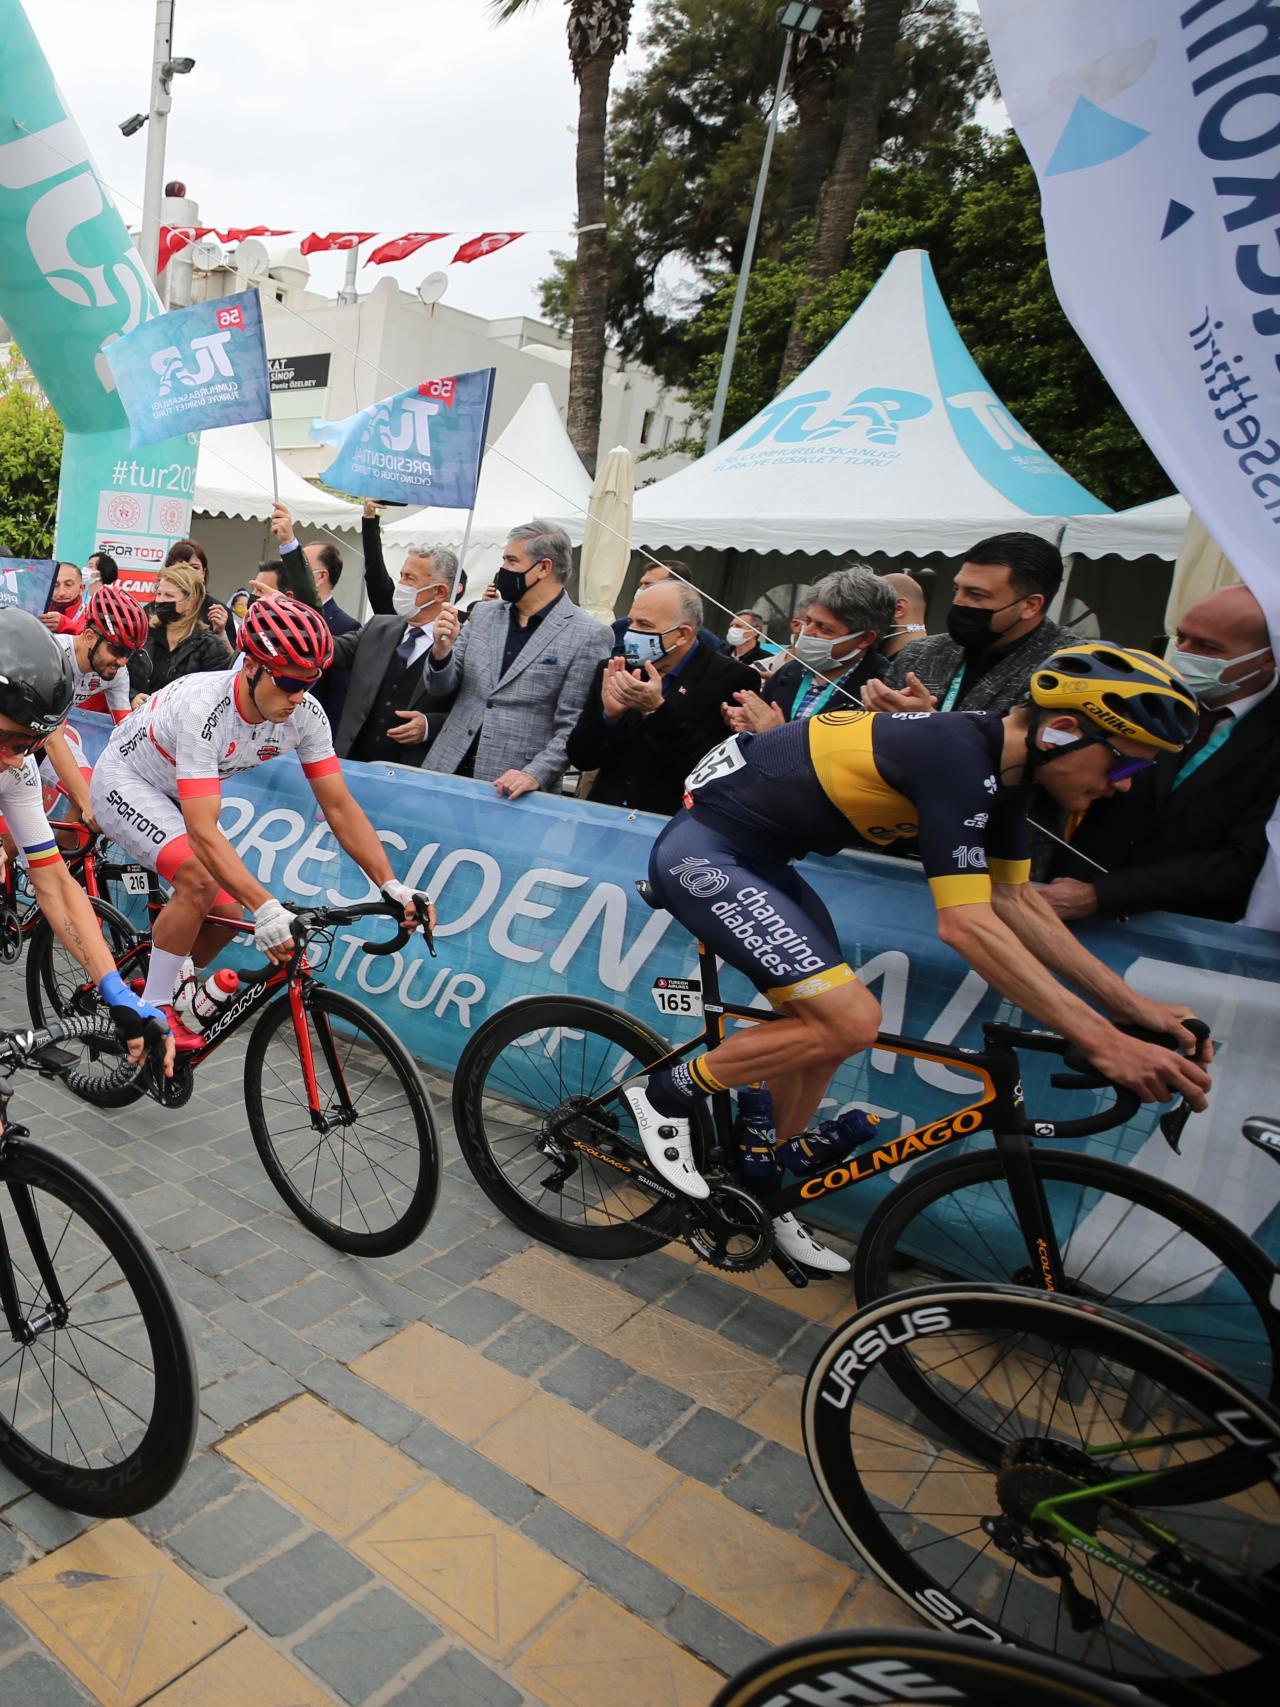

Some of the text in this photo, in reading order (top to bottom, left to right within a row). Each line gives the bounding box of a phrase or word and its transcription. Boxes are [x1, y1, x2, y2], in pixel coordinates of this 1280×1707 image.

[201, 696, 231, 741] SPORTOTO
[1082, 701, 1137, 736] catlike
[120, 727, 147, 757] SPORTOTO
[106, 790, 166, 845] SPORTOTO
[130, 875, 145, 890] 216
[670, 856, 730, 897] 100
[711, 900, 793, 977] diabetes
[736, 886, 826, 974] changing
[333, 934, 486, 1028] TOUR
[658, 993, 692, 1012] 165
[631, 1097, 652, 1131] nimbl
[580, 1142, 632, 1173] COLNAGO
[800, 1109, 983, 1199] COLNAGO
[637, 1174, 676, 1199] SHIMANO
[821, 1306, 951, 1409] URSUS
